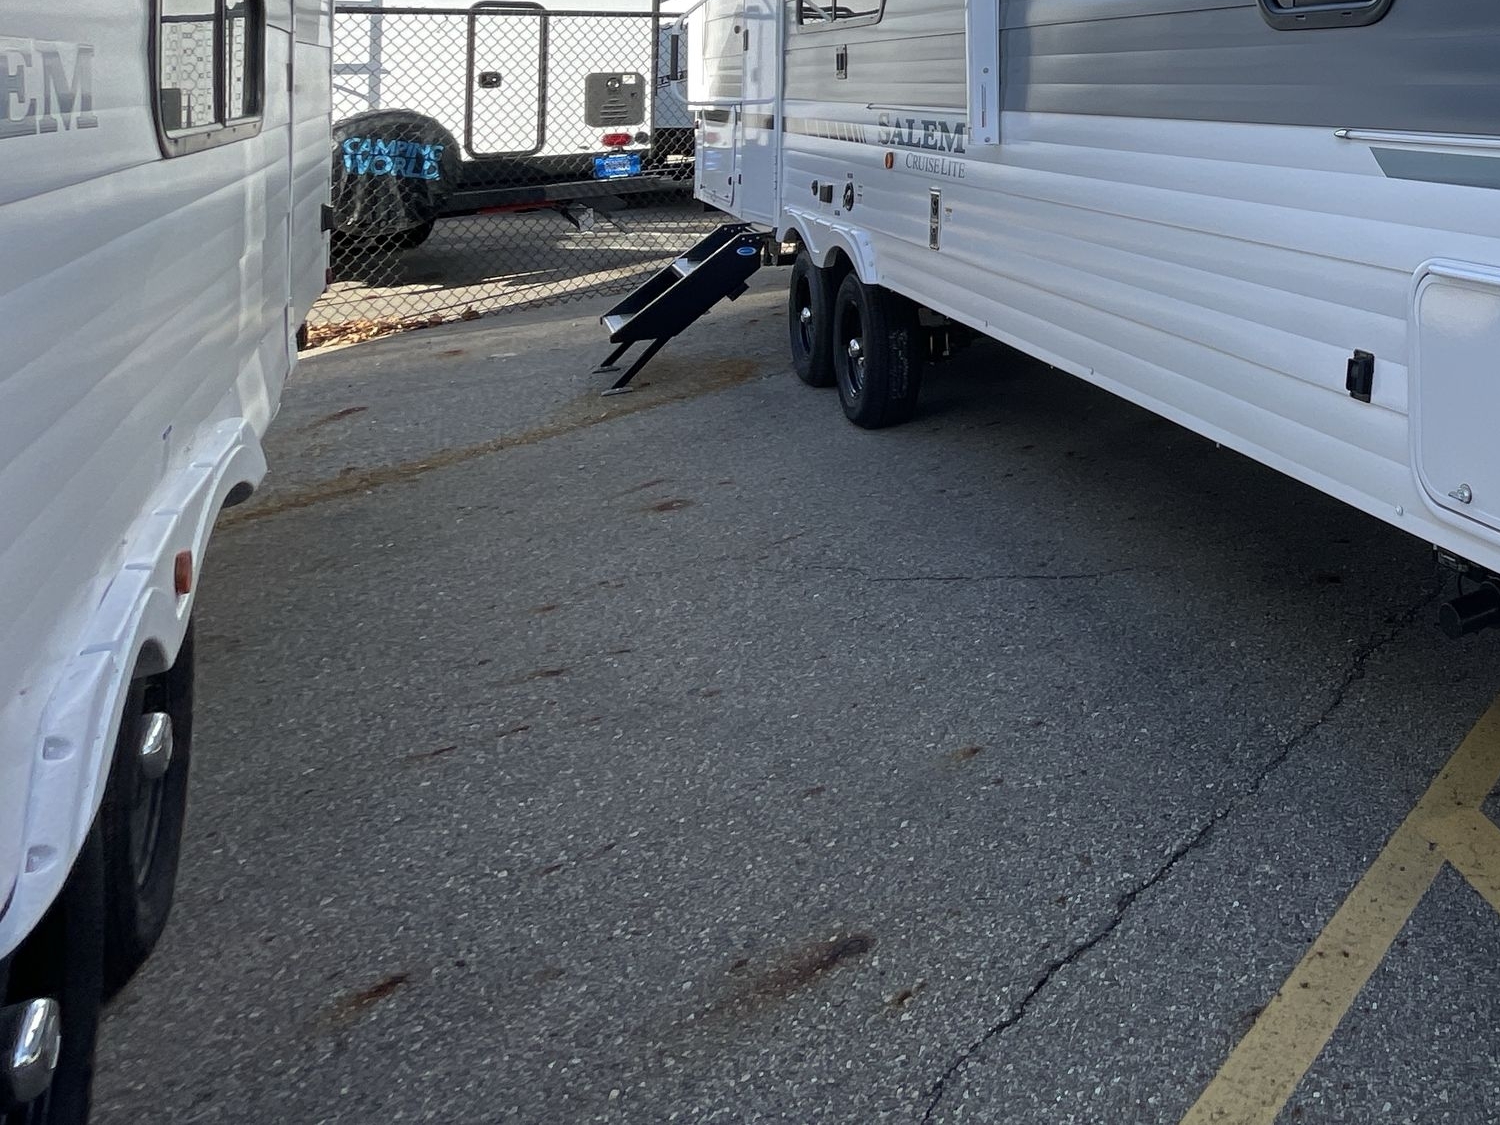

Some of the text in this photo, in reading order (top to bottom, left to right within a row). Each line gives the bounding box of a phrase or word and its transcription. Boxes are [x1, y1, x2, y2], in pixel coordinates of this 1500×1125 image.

[878, 112, 966, 154] SALEM
[342, 137, 445, 161] CAMPING
[343, 154, 440, 181] WORLD
